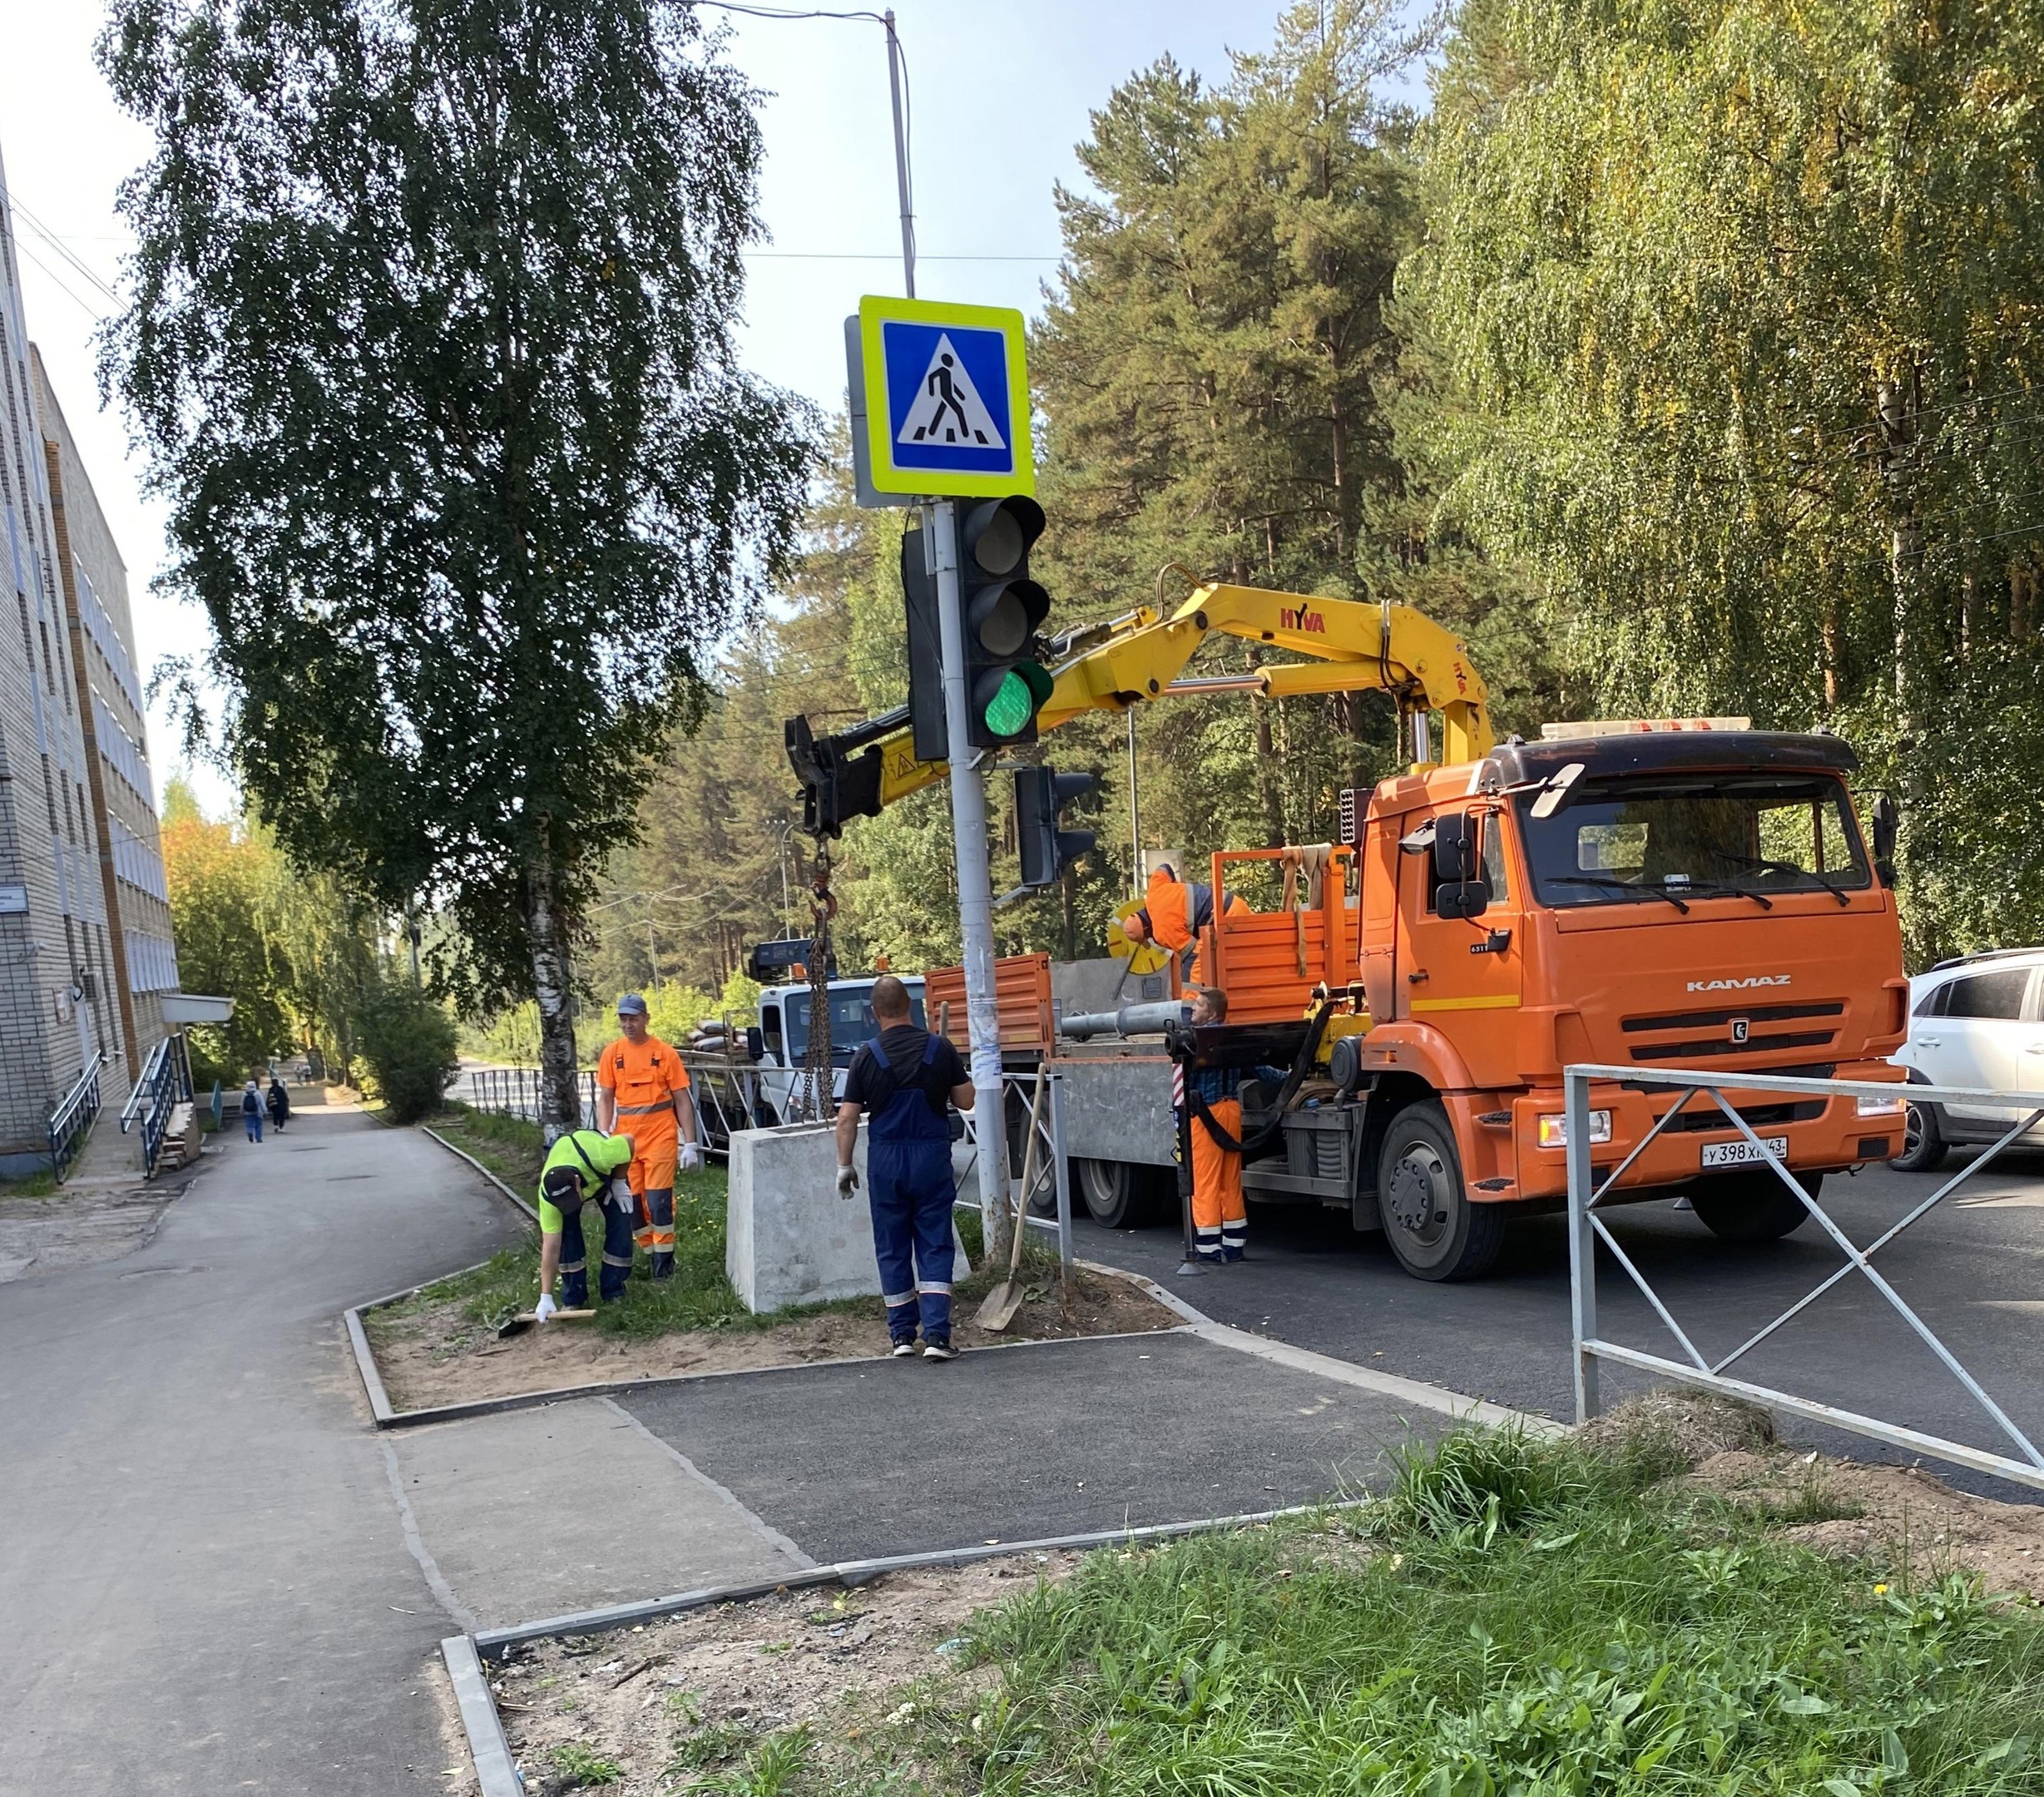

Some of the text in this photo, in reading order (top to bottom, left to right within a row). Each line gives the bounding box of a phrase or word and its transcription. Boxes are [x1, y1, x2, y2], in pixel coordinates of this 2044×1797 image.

[1280, 603, 1325, 634] HYVA
[1453, 661, 1467, 696] HYVA
[1686, 974, 1791, 992] KAMAZ
[1720, 1144, 1745, 1161] 398
[1769, 1140, 1782, 1152] 43
